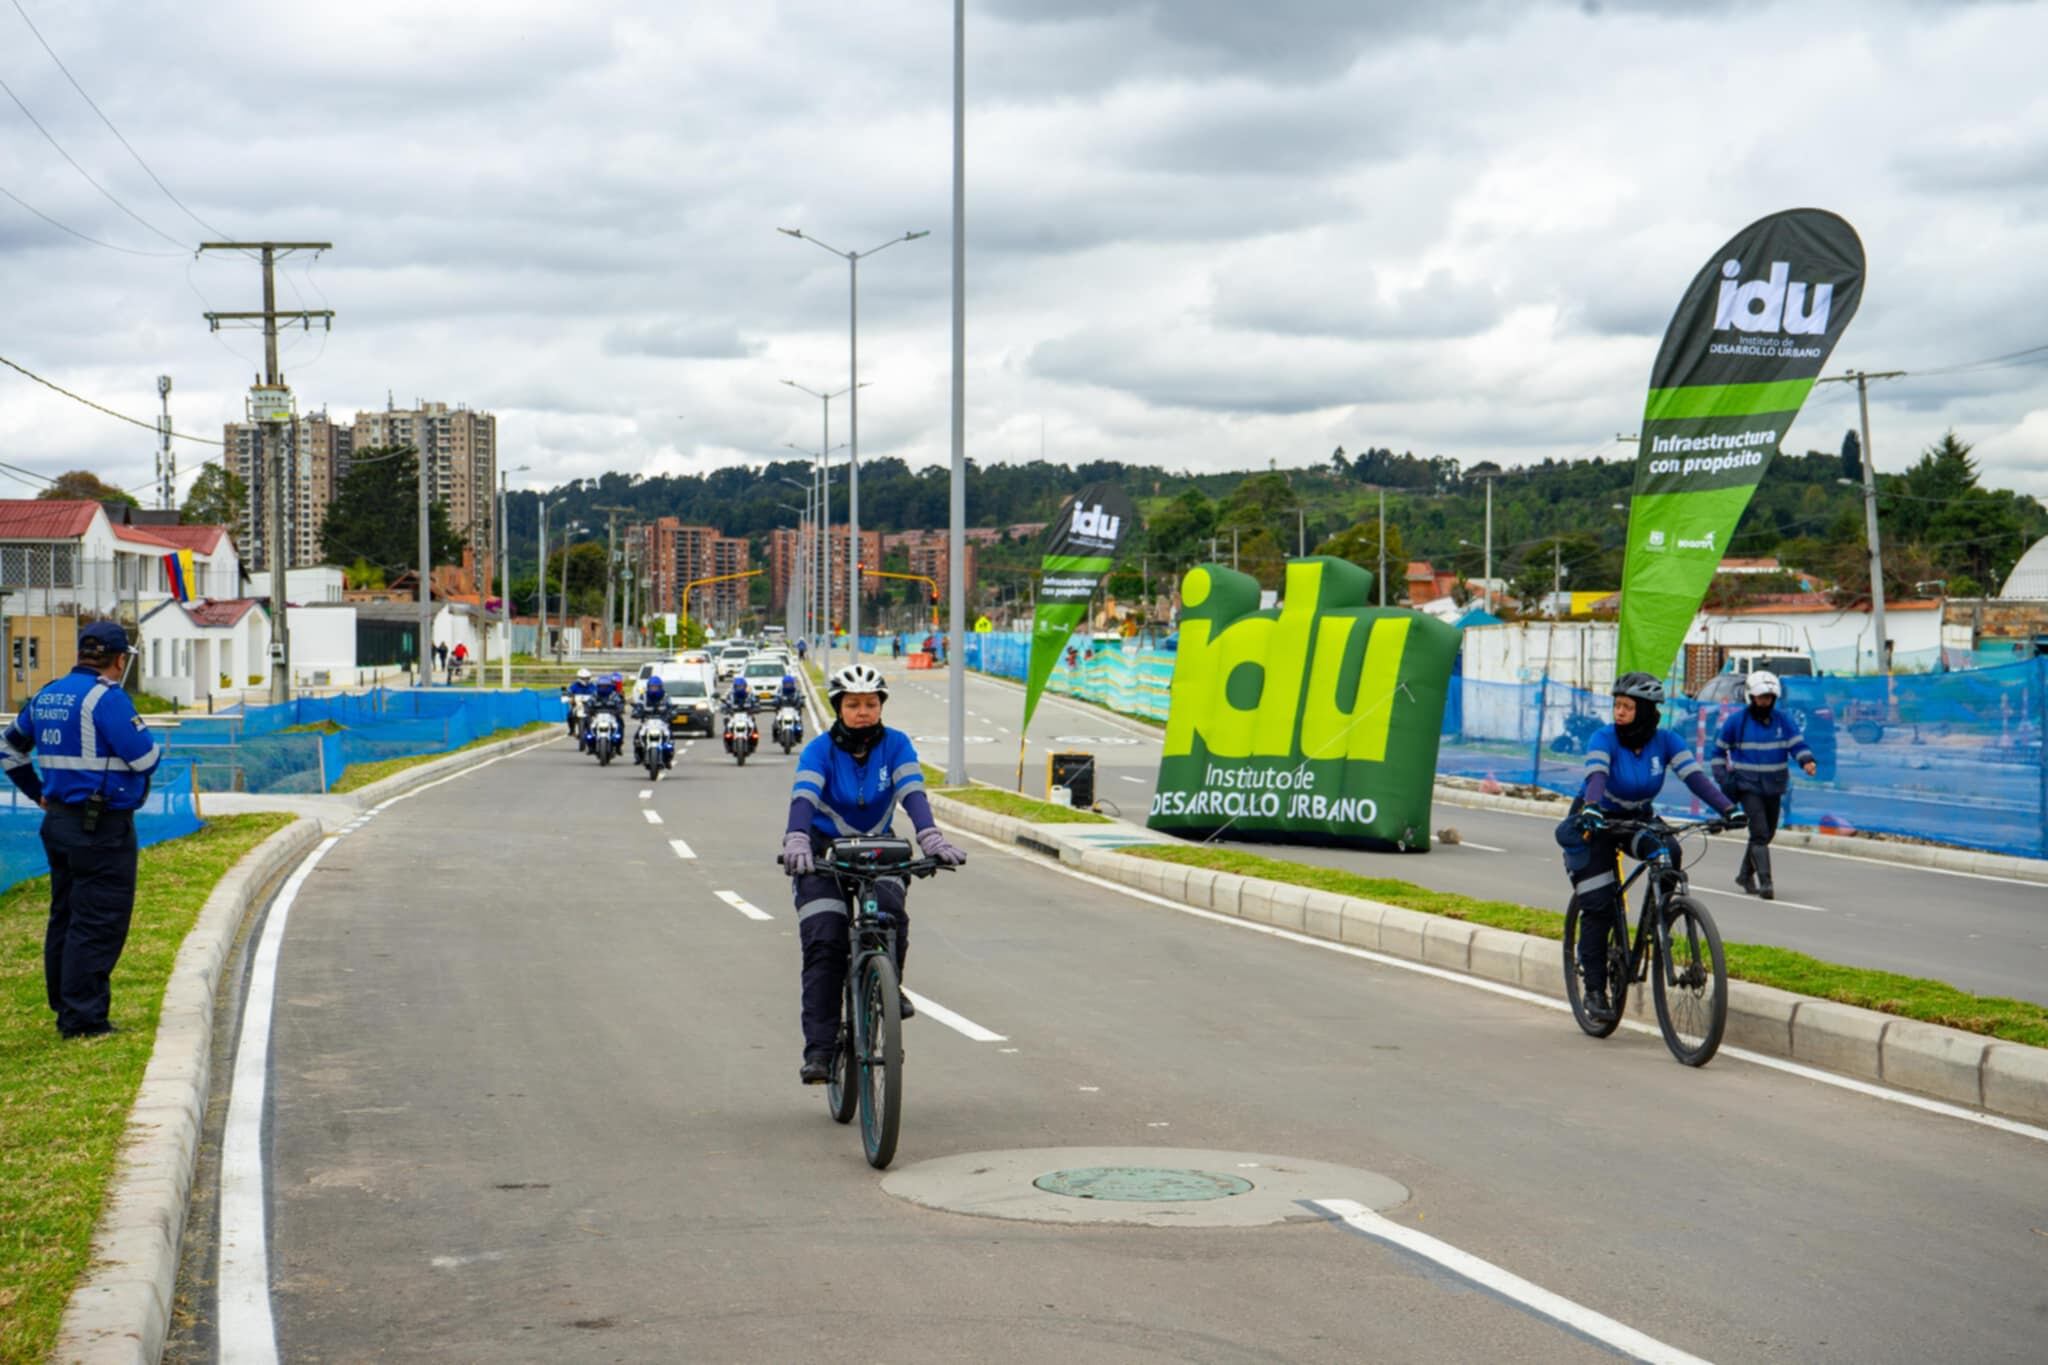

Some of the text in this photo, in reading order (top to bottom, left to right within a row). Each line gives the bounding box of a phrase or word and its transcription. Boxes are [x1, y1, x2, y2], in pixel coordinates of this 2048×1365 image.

[1713, 259, 1833, 334] idu
[1709, 344, 1821, 358] DESARROLLO URBANO
[1652, 430, 1776, 453] Infraestructura
[1650, 450, 1762, 476] con propósito
[1069, 501, 1120, 539] idu
[1162, 562, 1412, 761] idu
[41, 728, 62, 745] 400
